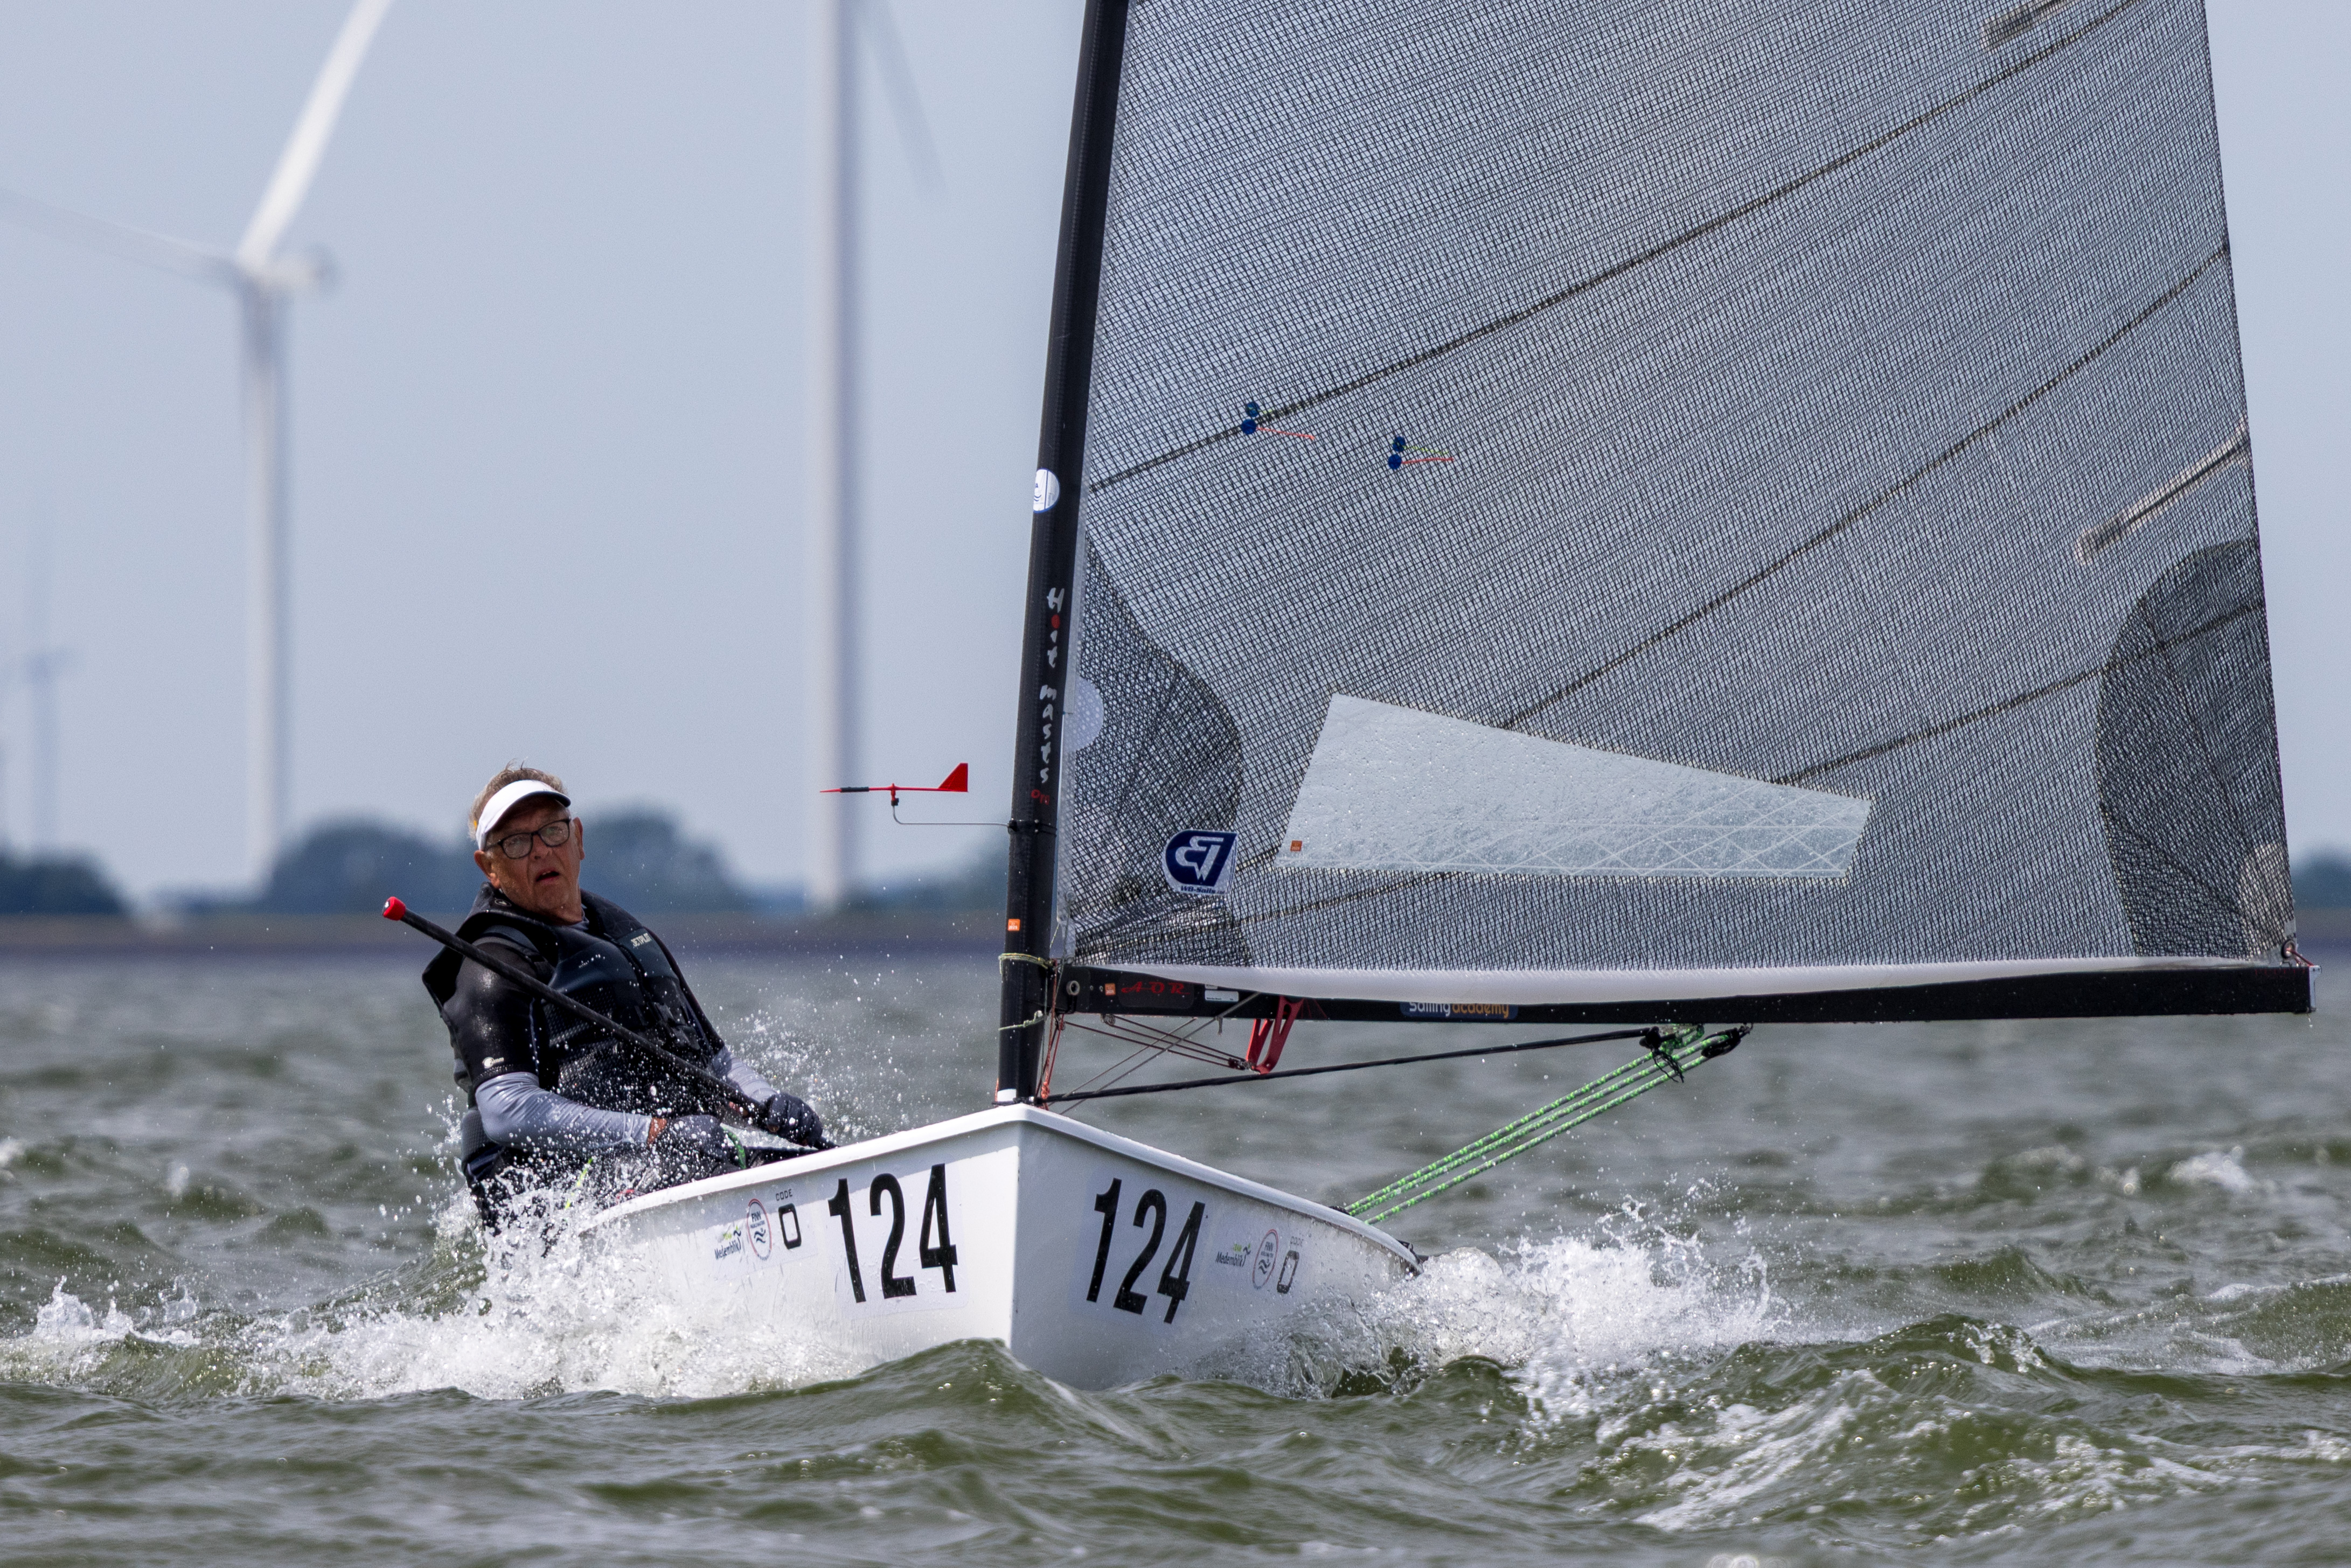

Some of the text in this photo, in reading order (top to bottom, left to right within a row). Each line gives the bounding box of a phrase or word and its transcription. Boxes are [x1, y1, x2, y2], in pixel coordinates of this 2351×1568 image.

[1040, 685, 1057, 784] masts
[1181, 885, 1216, 894] WB-Sails
[776, 1189, 792, 1201] CODE
[827, 1163, 958, 1303] 124
[1086, 1177, 1205, 1324] 124
